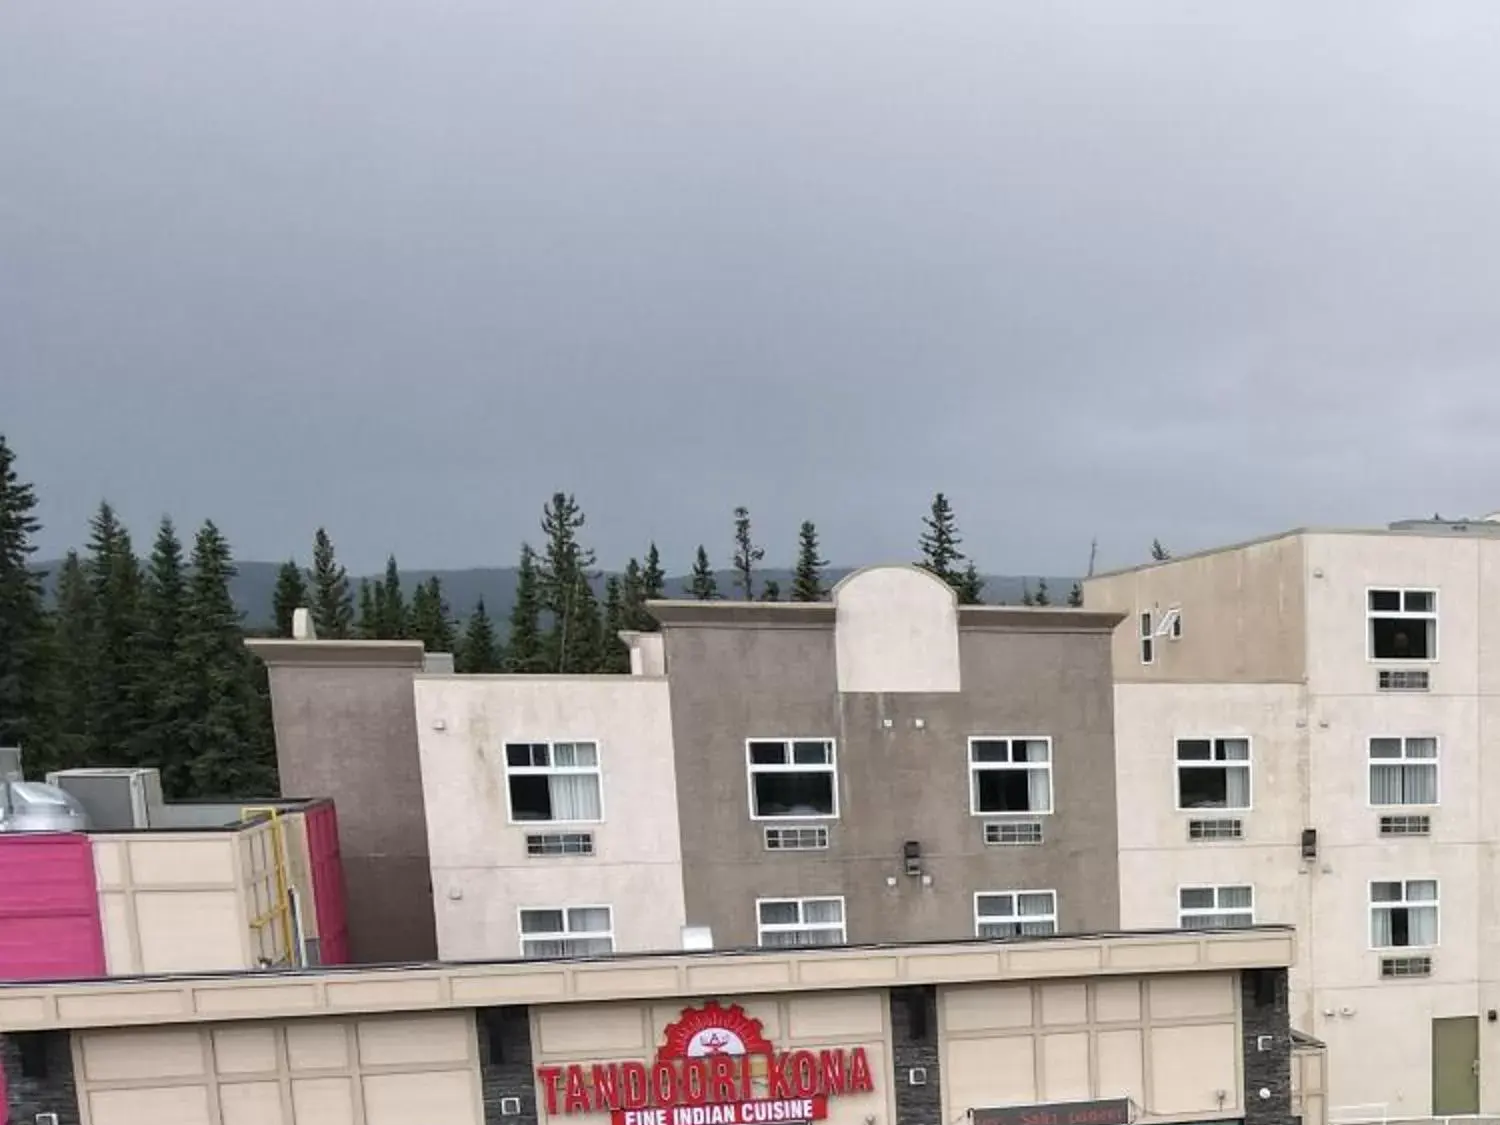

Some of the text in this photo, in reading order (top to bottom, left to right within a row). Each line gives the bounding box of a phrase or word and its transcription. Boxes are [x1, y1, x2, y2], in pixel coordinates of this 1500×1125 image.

[538, 1047, 874, 1116] TANDOORI KONA
[741, 1099, 813, 1121] CUISINE
